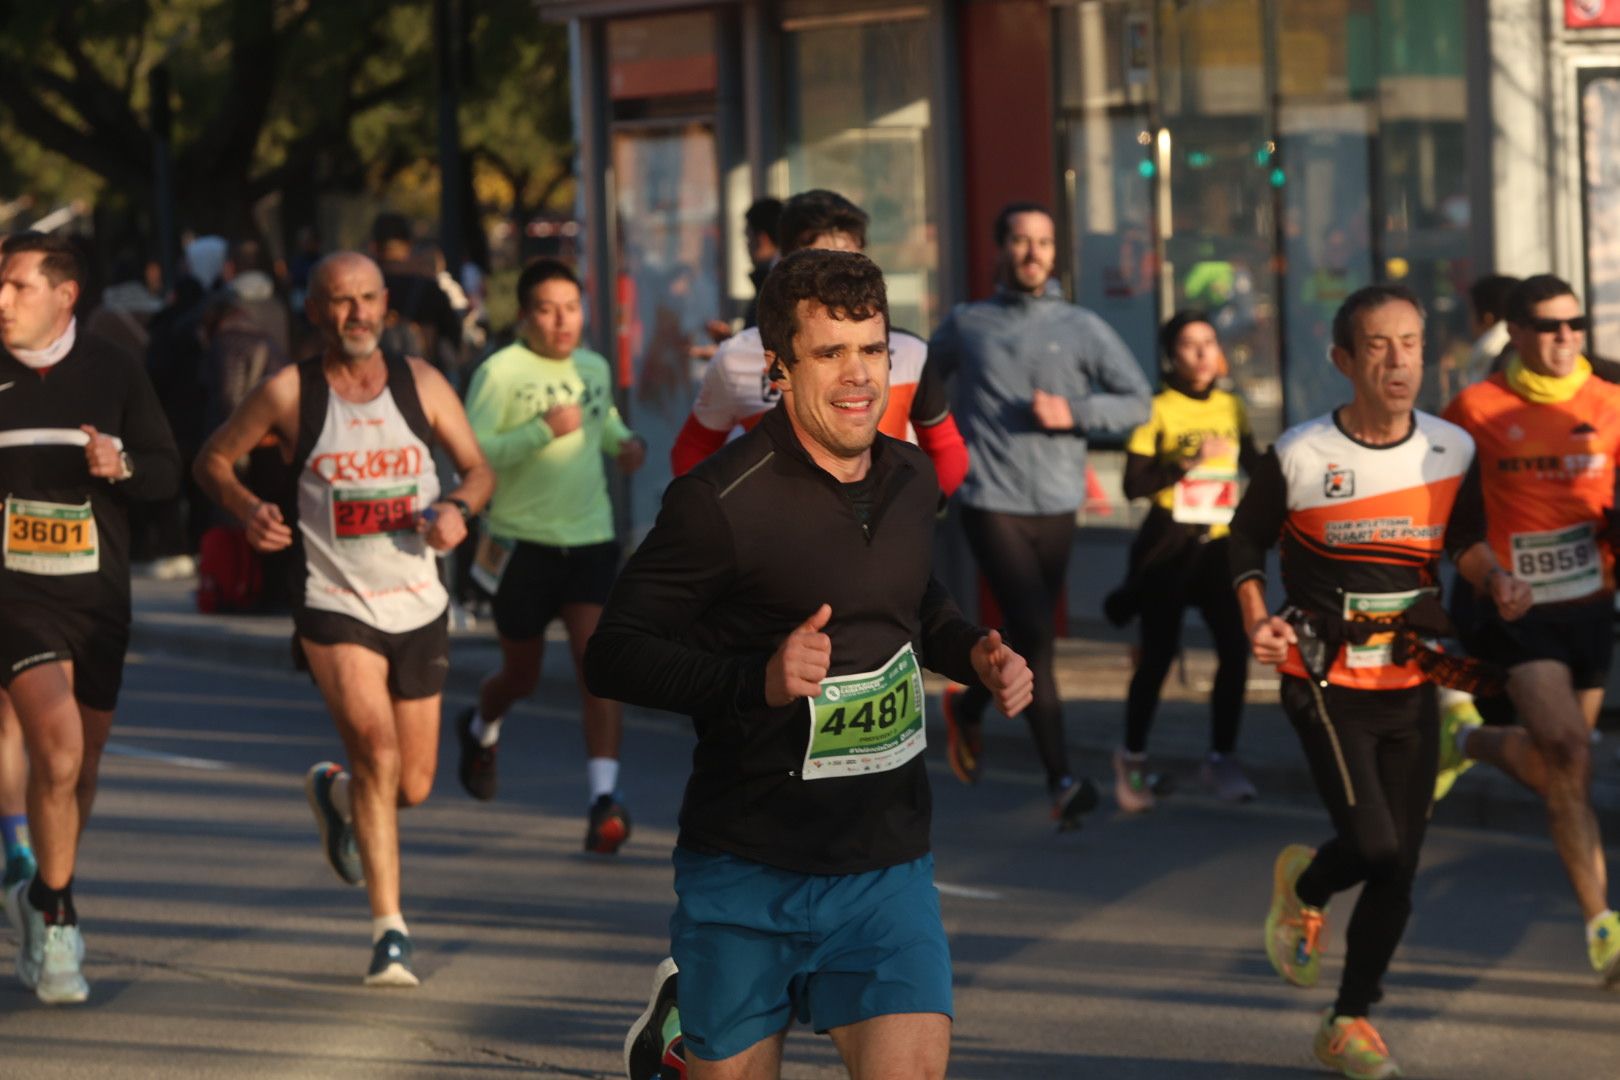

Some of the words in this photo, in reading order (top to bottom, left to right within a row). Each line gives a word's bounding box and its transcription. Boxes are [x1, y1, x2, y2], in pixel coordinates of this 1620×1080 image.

[13, 518, 82, 544] 3601
[1519, 544, 1588, 575] 8959
[820, 680, 908, 735] 4487
